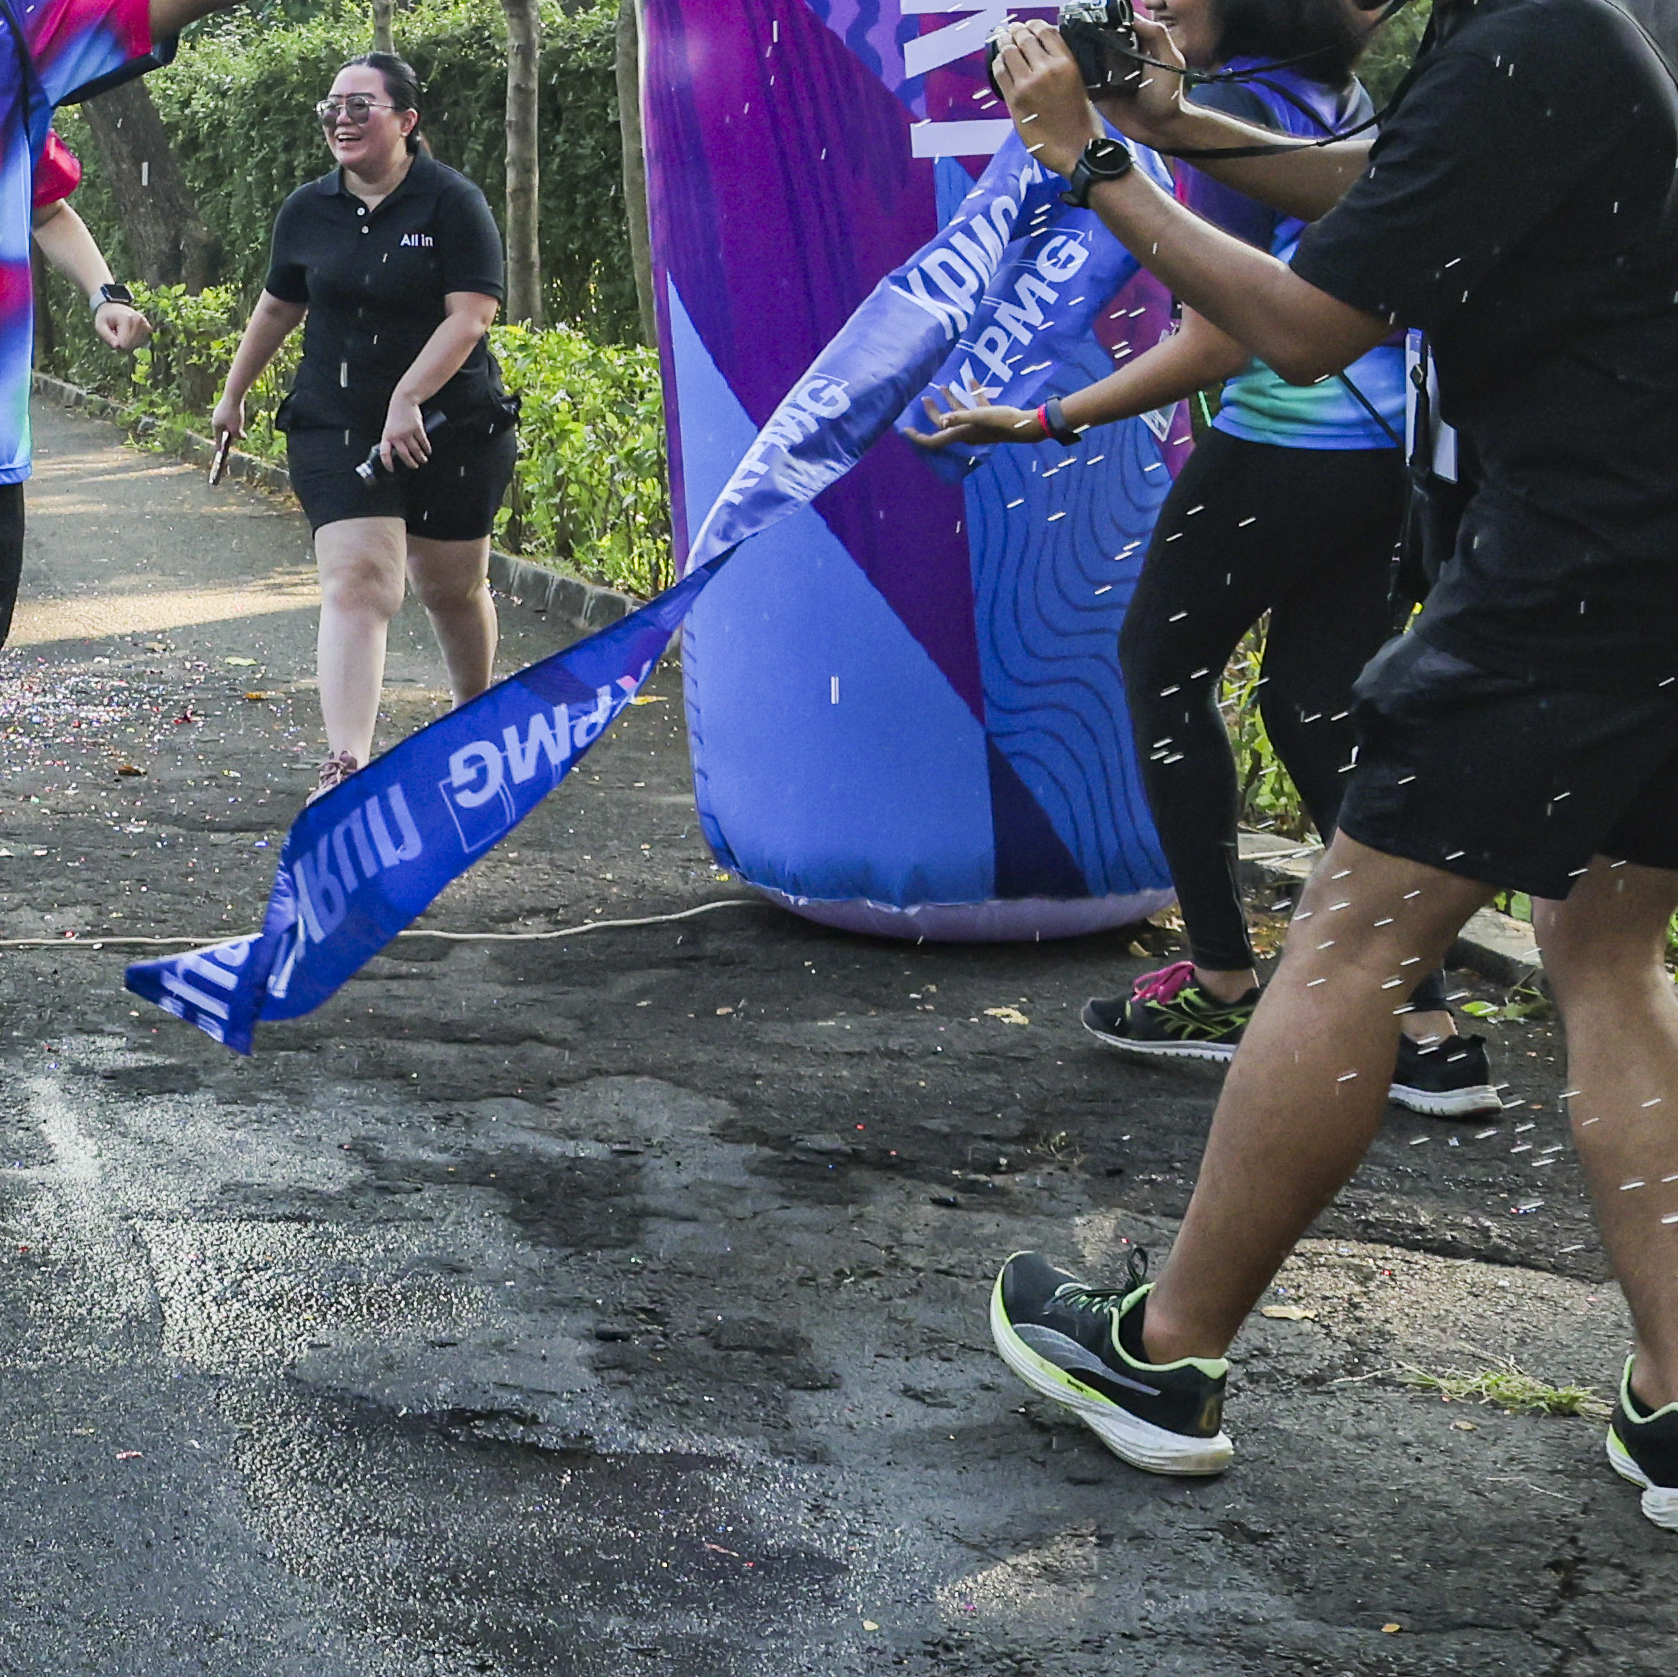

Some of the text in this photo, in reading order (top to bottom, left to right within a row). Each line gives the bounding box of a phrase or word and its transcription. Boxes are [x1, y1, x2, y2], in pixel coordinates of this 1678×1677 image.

[400, 233, 434, 247] All in
[948, 234, 1090, 410] KPMG
